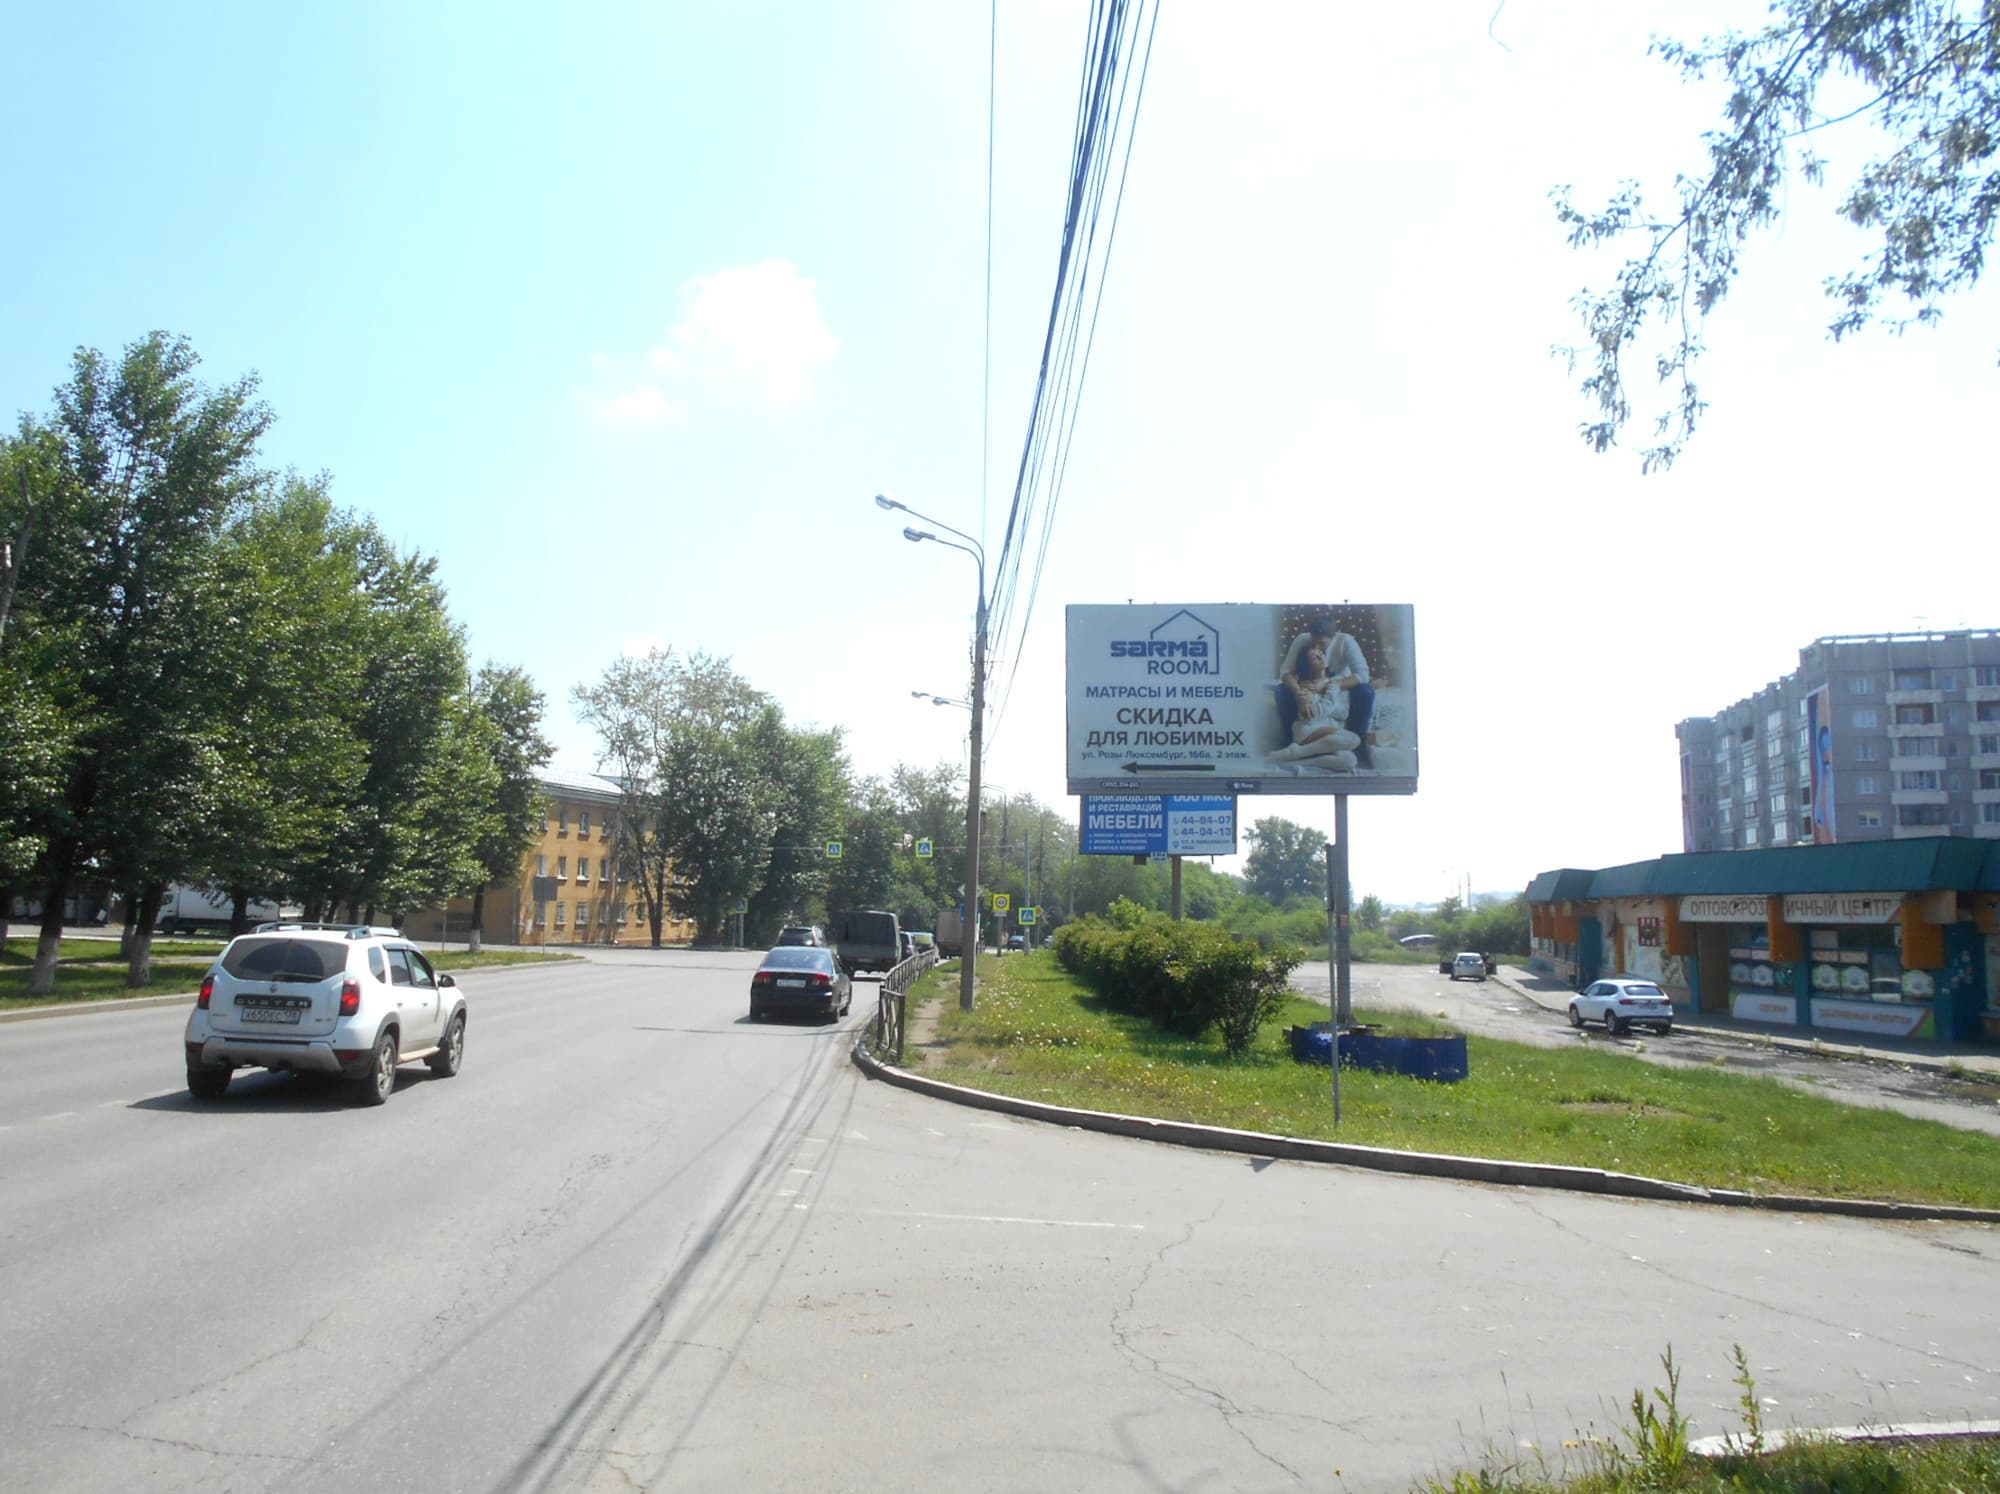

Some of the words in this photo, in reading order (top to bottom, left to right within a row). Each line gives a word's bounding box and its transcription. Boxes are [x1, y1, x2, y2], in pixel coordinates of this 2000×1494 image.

[1147, 660, 1209, 675] ROOM
[1086, 686, 1161, 699] МАТРАСЫ
[1166, 686, 1177, 699] И
[1181, 686, 1244, 699] МЕБЕЛЬ
[1116, 707, 1214, 728] СКИДКА
[1087, 731, 1128, 749] ДЛЯ
[1134, 731, 1245, 746] ЛЮБИМЫХ
[1098, 751, 1122, 760] Розы
[1089, 804, 1096, 812] И
[1097, 804, 1162, 813] РЕСТАВРАЦИИ
[1089, 815, 1163, 829] МЕБЕЛИ
[1842, 899, 1892, 920] ЦЕНТР
